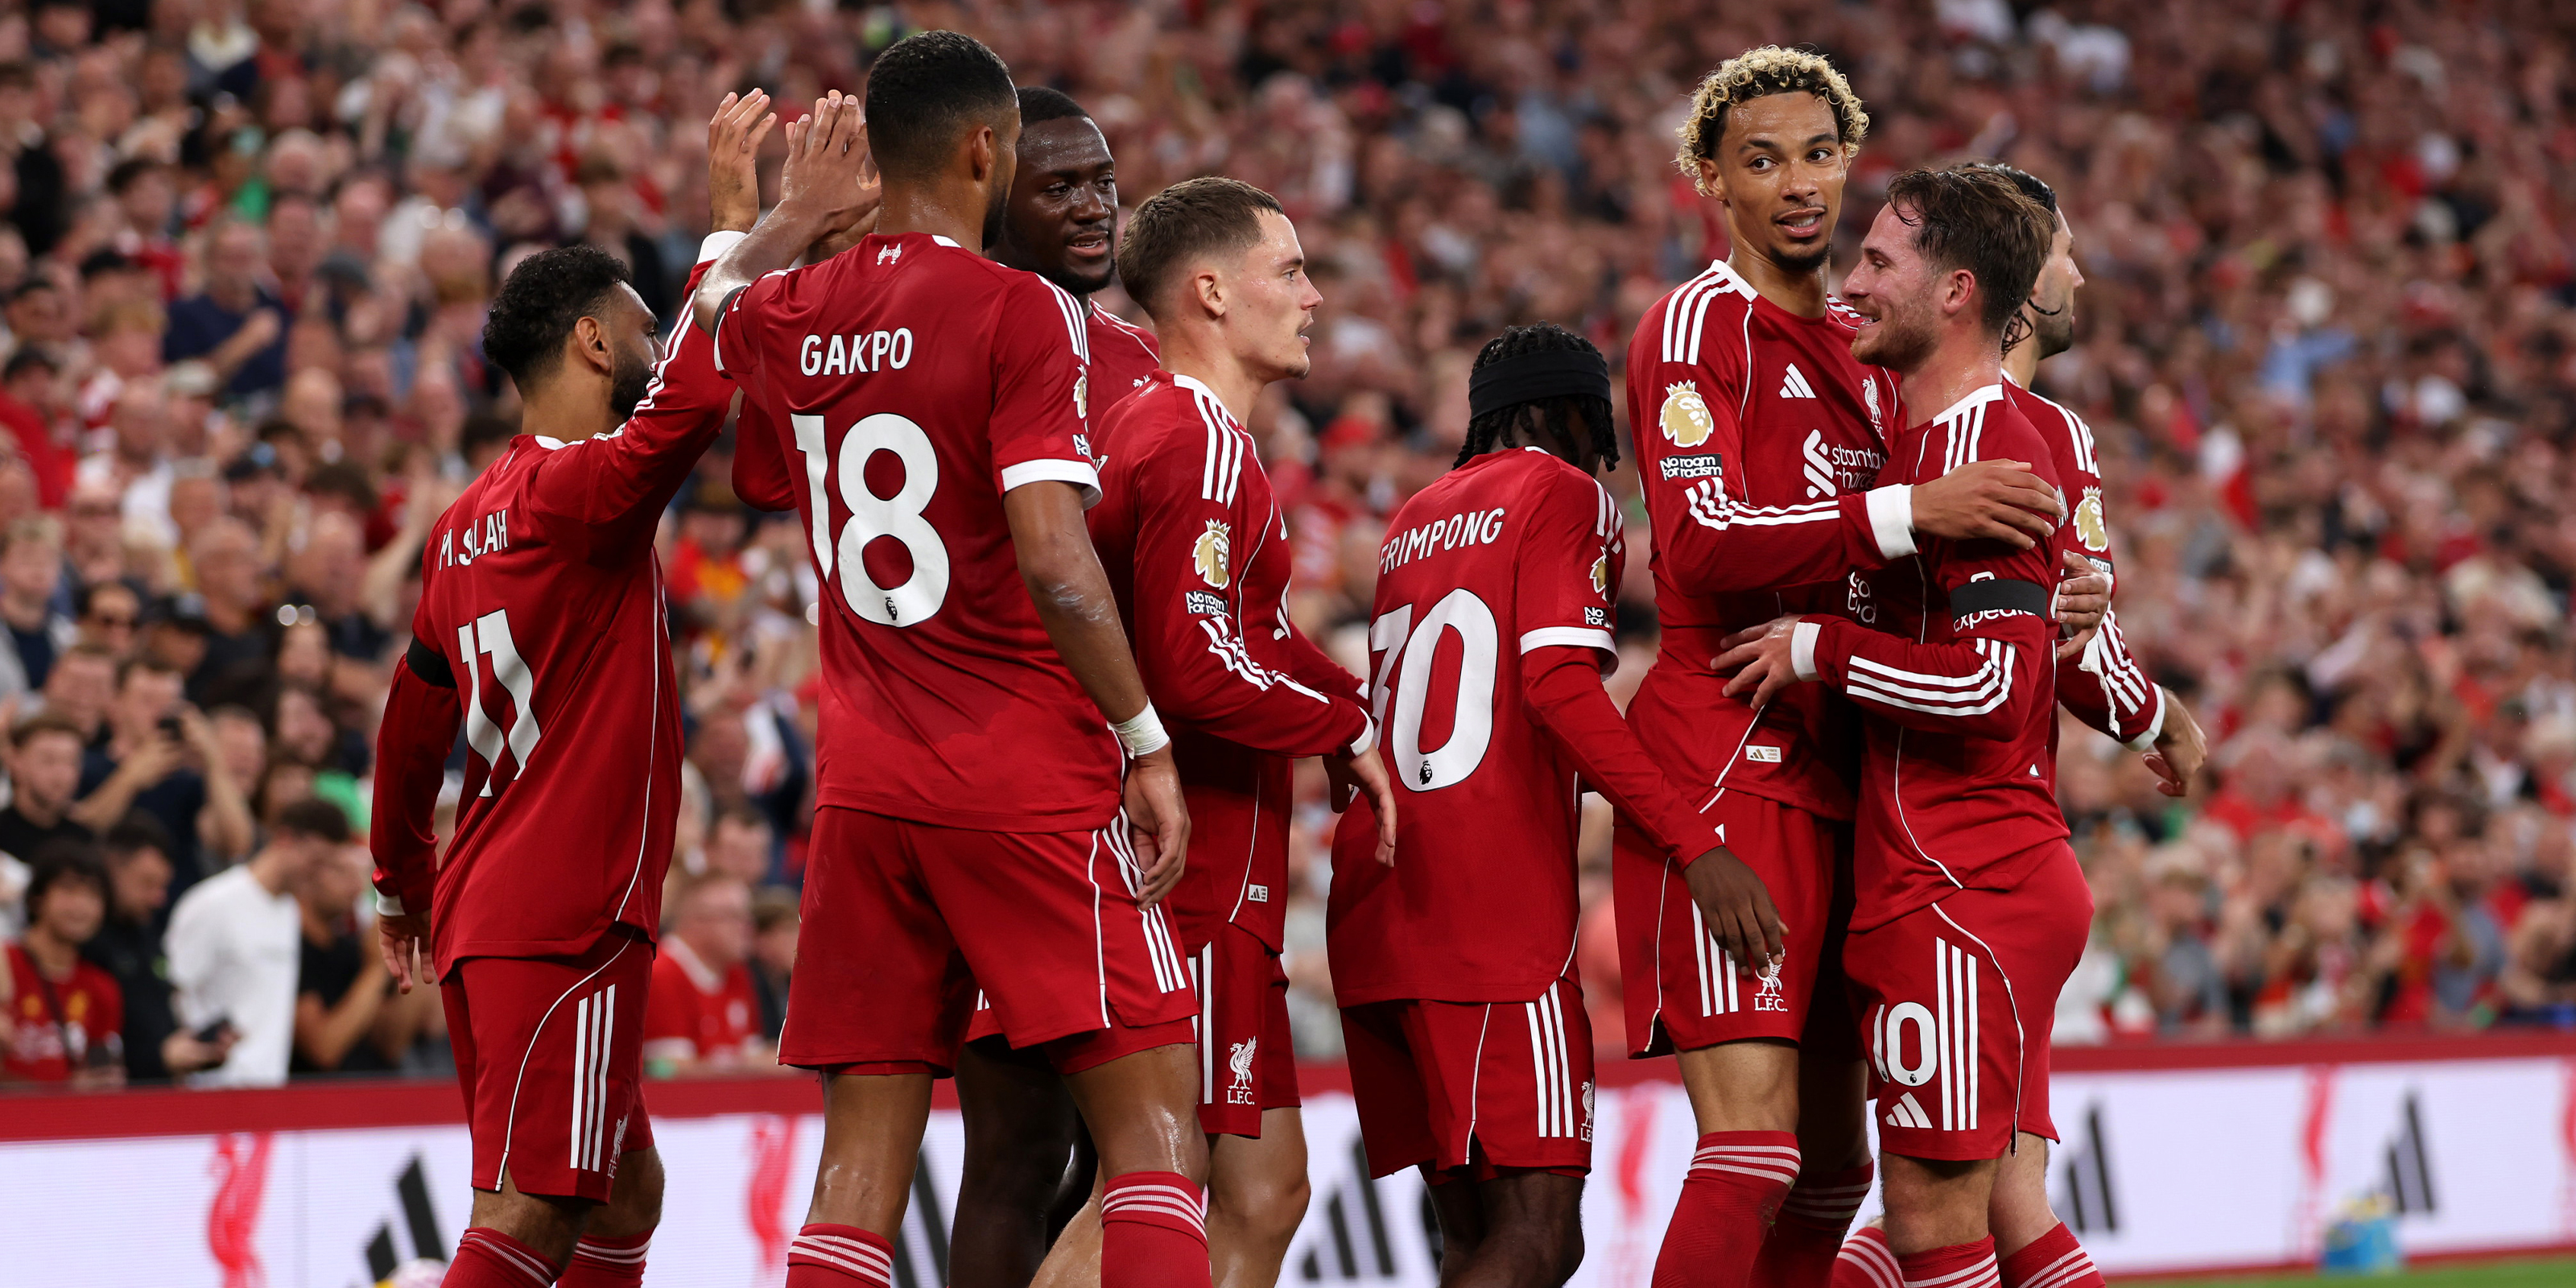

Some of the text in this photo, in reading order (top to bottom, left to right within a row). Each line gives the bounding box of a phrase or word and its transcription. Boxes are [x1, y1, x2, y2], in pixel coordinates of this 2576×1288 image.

[801, 328, 913, 376] GAKPO
[1660, 456, 1715, 471] No room
[1680, 466, 1723, 478] racism
[791, 413, 951, 628] 18
[1379, 507, 1505, 575] FRIMPONG
[1185, 591, 1204, 604] No
[1583, 606, 1604, 617] No
[457, 608, 542, 798] 11
[1369, 588, 1499, 792] 30
[1753, 997, 1788, 1012] L.F.C.
[1872, 1001, 1938, 1087] 10
[1227, 1090, 1255, 1105] L.F.C.
